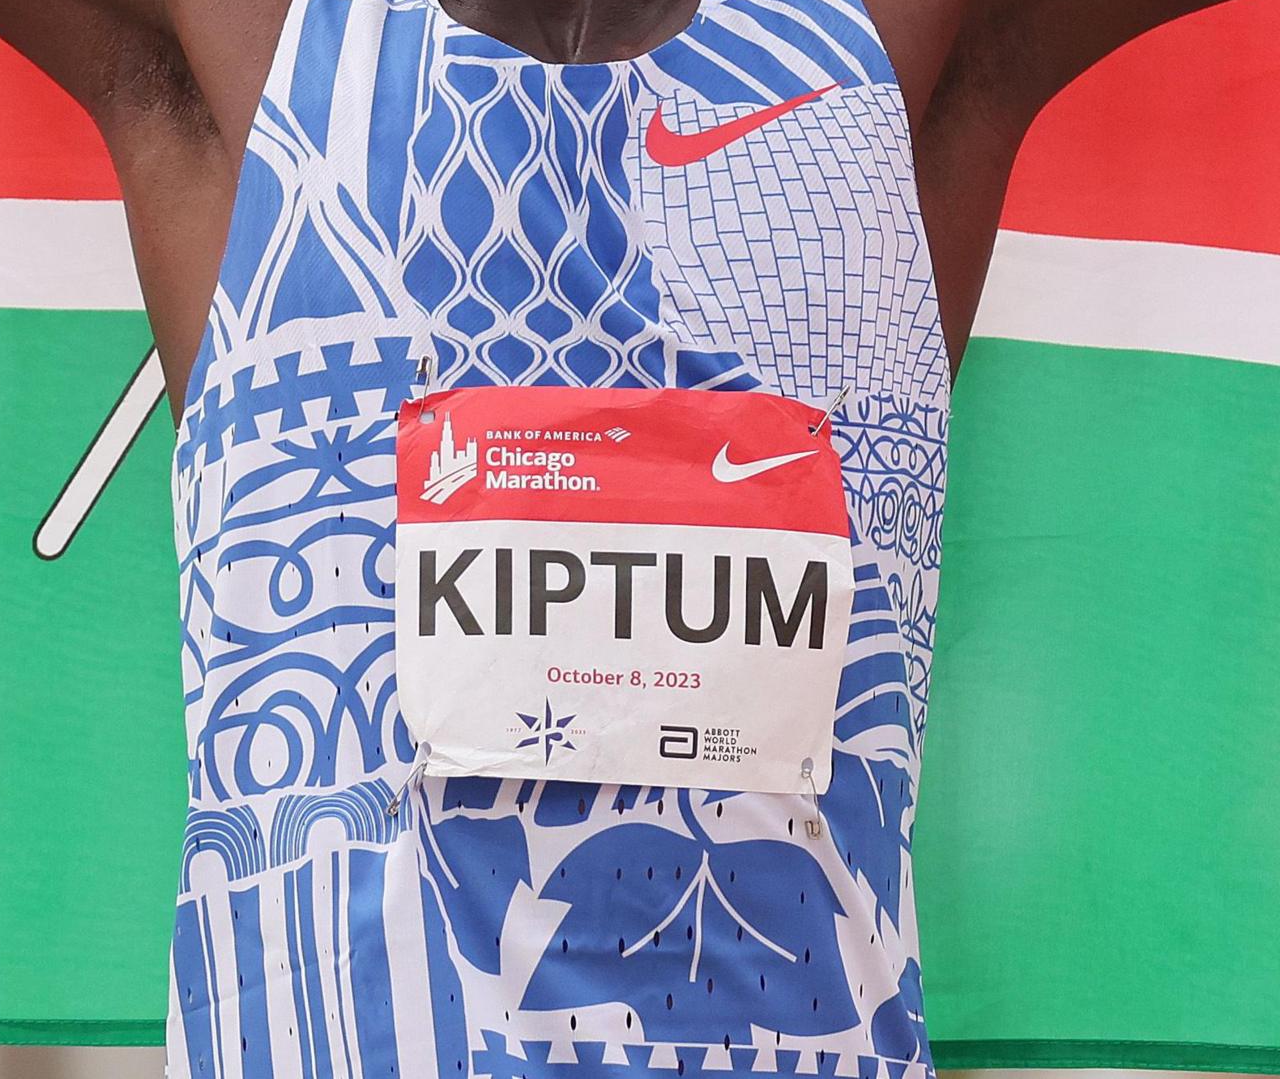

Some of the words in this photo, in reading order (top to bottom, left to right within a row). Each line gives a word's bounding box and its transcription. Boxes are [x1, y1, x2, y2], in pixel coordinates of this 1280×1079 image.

[485, 430, 521, 440] BANK
[524, 430, 541, 440] OF
[543, 430, 602, 442] AMERICA
[485, 446, 575, 471] Chicago
[418, 547, 828, 650] KIPTUM
[546, 666, 624, 686] October
[629, 670, 647, 689] 8,
[653, 670, 702, 689] 2023
[704, 728, 741, 737] ABBOTT
[704, 736, 737, 745] WORLD
[703, 745, 757, 755] MARATHON
[703, 754, 741, 763] MAJORS
